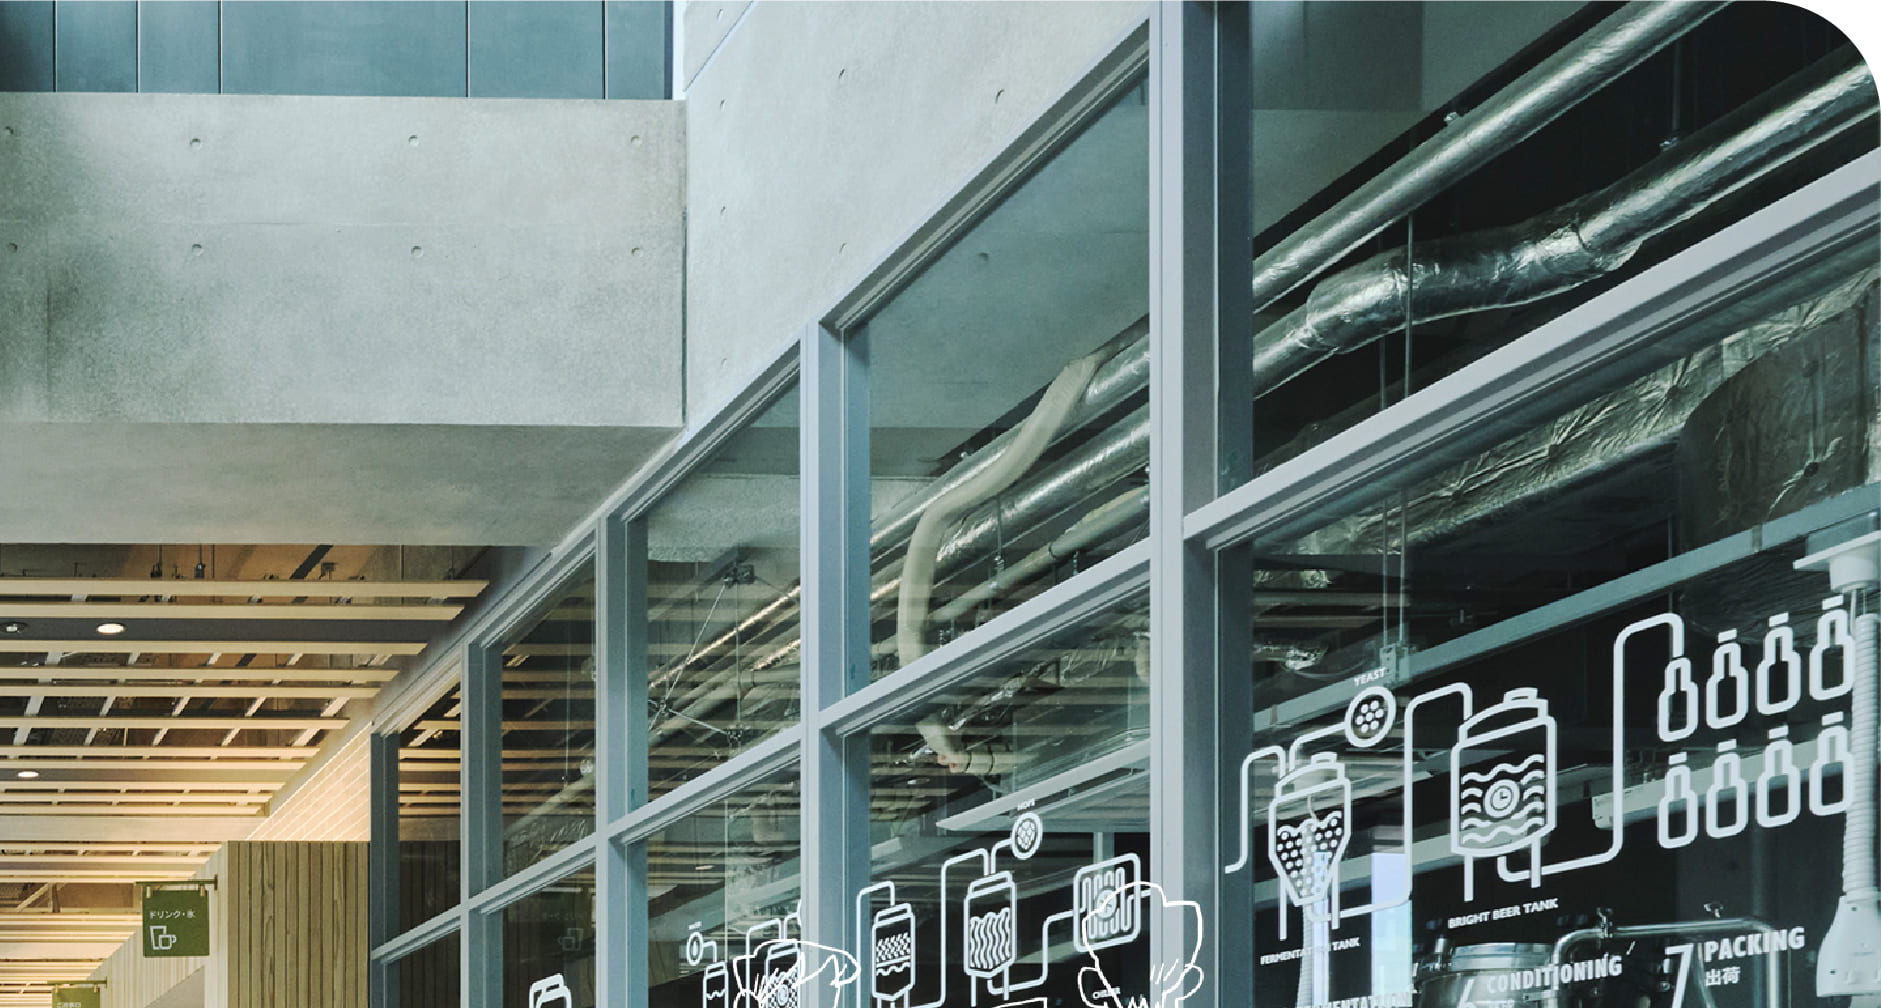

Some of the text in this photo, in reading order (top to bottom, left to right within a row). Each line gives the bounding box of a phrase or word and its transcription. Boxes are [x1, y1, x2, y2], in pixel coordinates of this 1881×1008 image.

[1354, 667, 1385, 687] YEAST
[1448, 898, 1558, 929] BRIGHT BEER TANK
[1332, 937, 1361, 951] TANK
[1704, 926, 1806, 963] PACKING
[1487, 954, 1623, 994] CONDITIONING
[1705, 966, 1741, 987] 出荷
